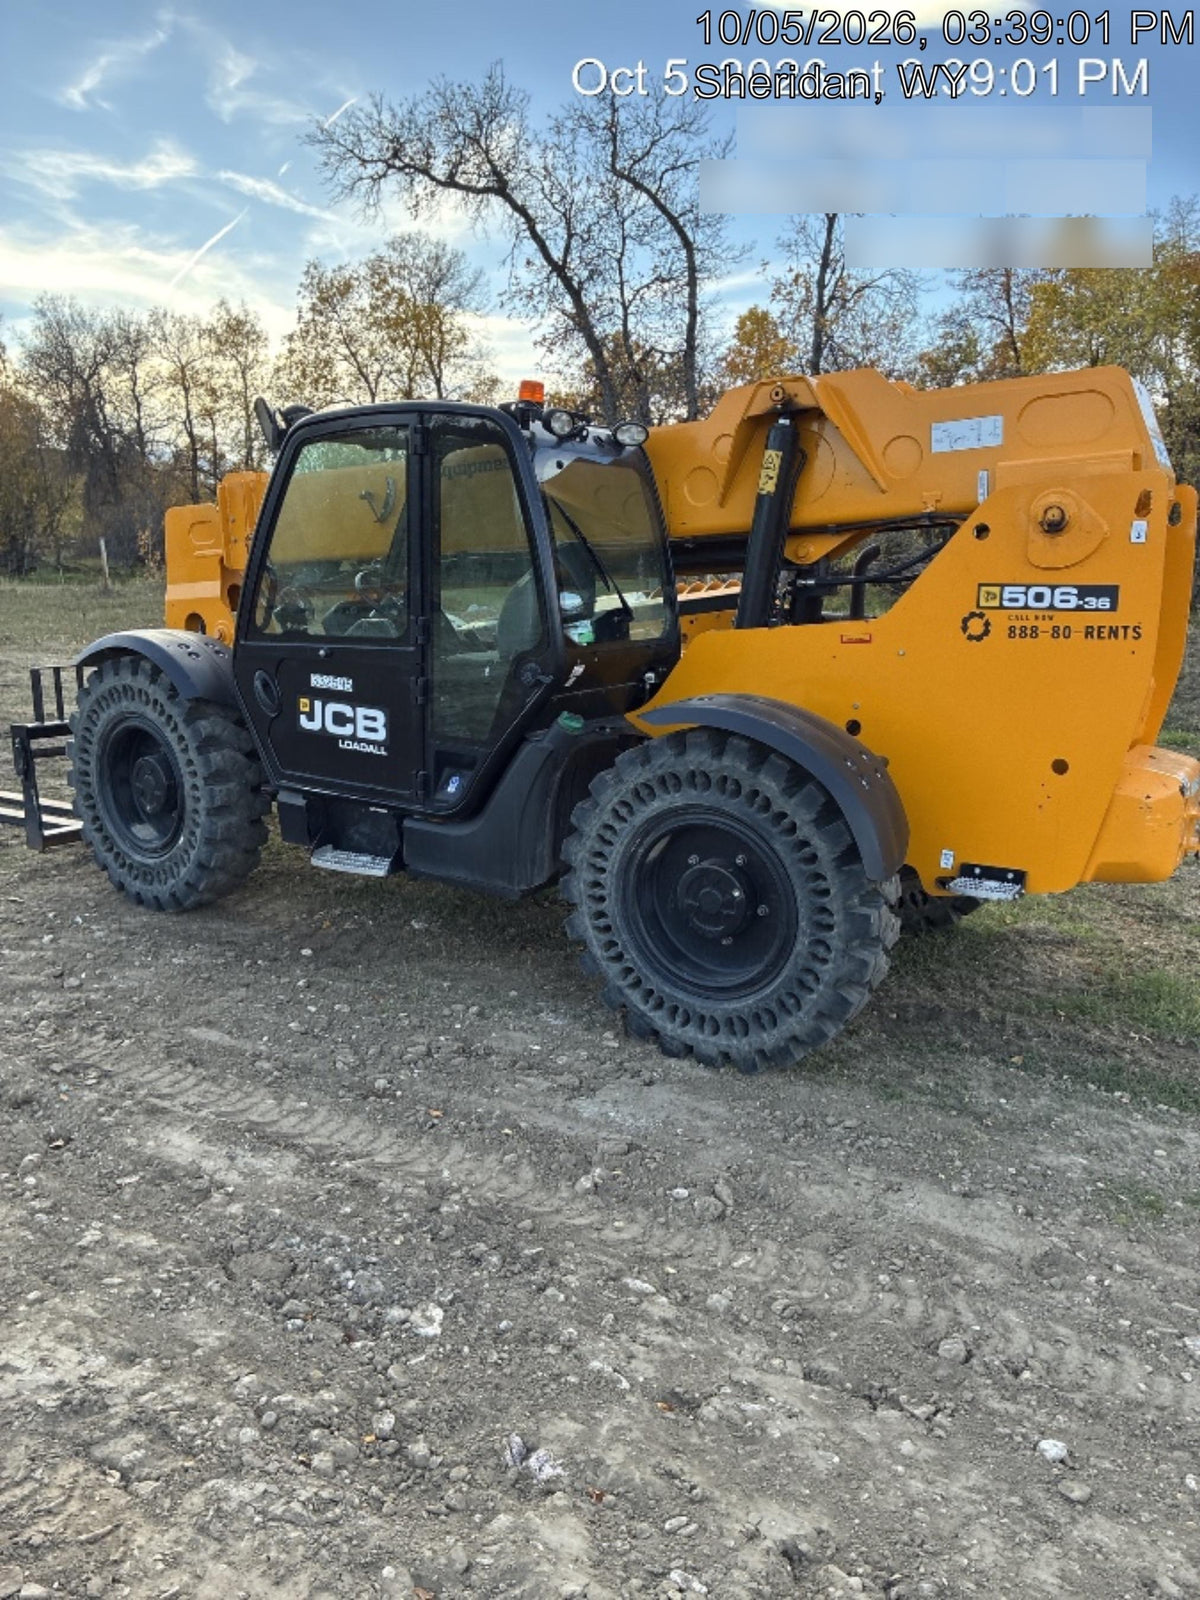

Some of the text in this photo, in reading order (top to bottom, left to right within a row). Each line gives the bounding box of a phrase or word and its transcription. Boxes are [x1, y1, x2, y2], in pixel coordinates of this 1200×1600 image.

[1002, 586, 1111, 609] 506-36
[1007, 614, 1031, 622] CALL
[1007, 625, 1142, 640] 888-80-RENTS
[300, 699, 386, 741] JCB
[338, 739, 388, 757] LOADALL
